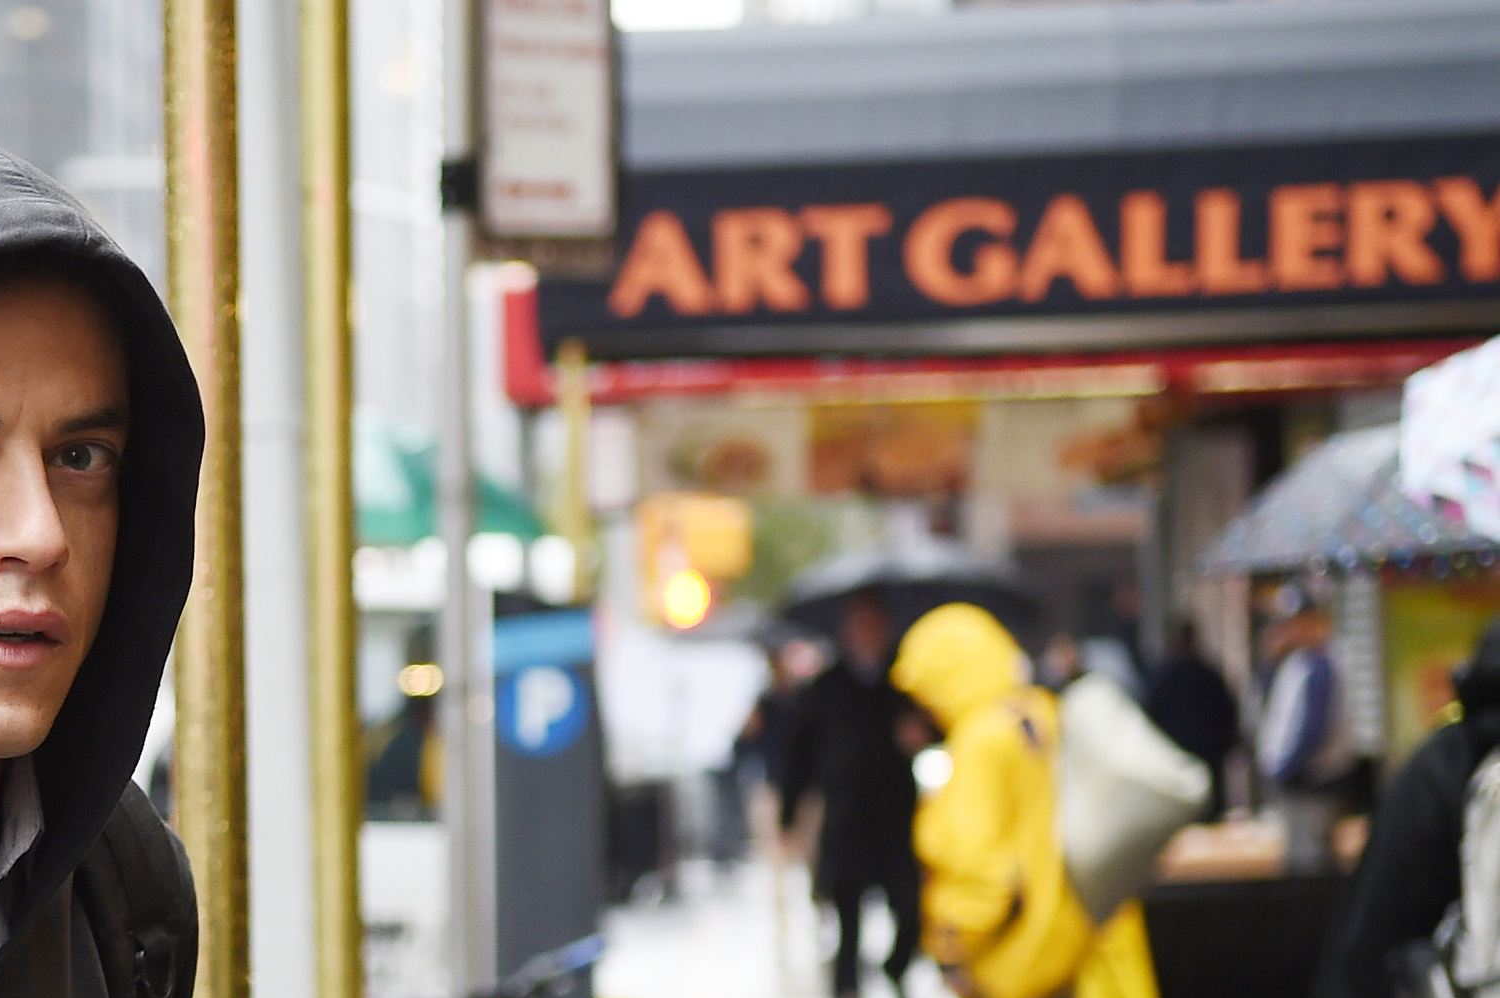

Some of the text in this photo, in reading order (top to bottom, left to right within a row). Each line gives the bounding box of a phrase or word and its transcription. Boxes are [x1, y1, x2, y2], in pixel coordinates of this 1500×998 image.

[608, 175, 1500, 318] ART GALLERY
[516, 666, 574, 747] P
